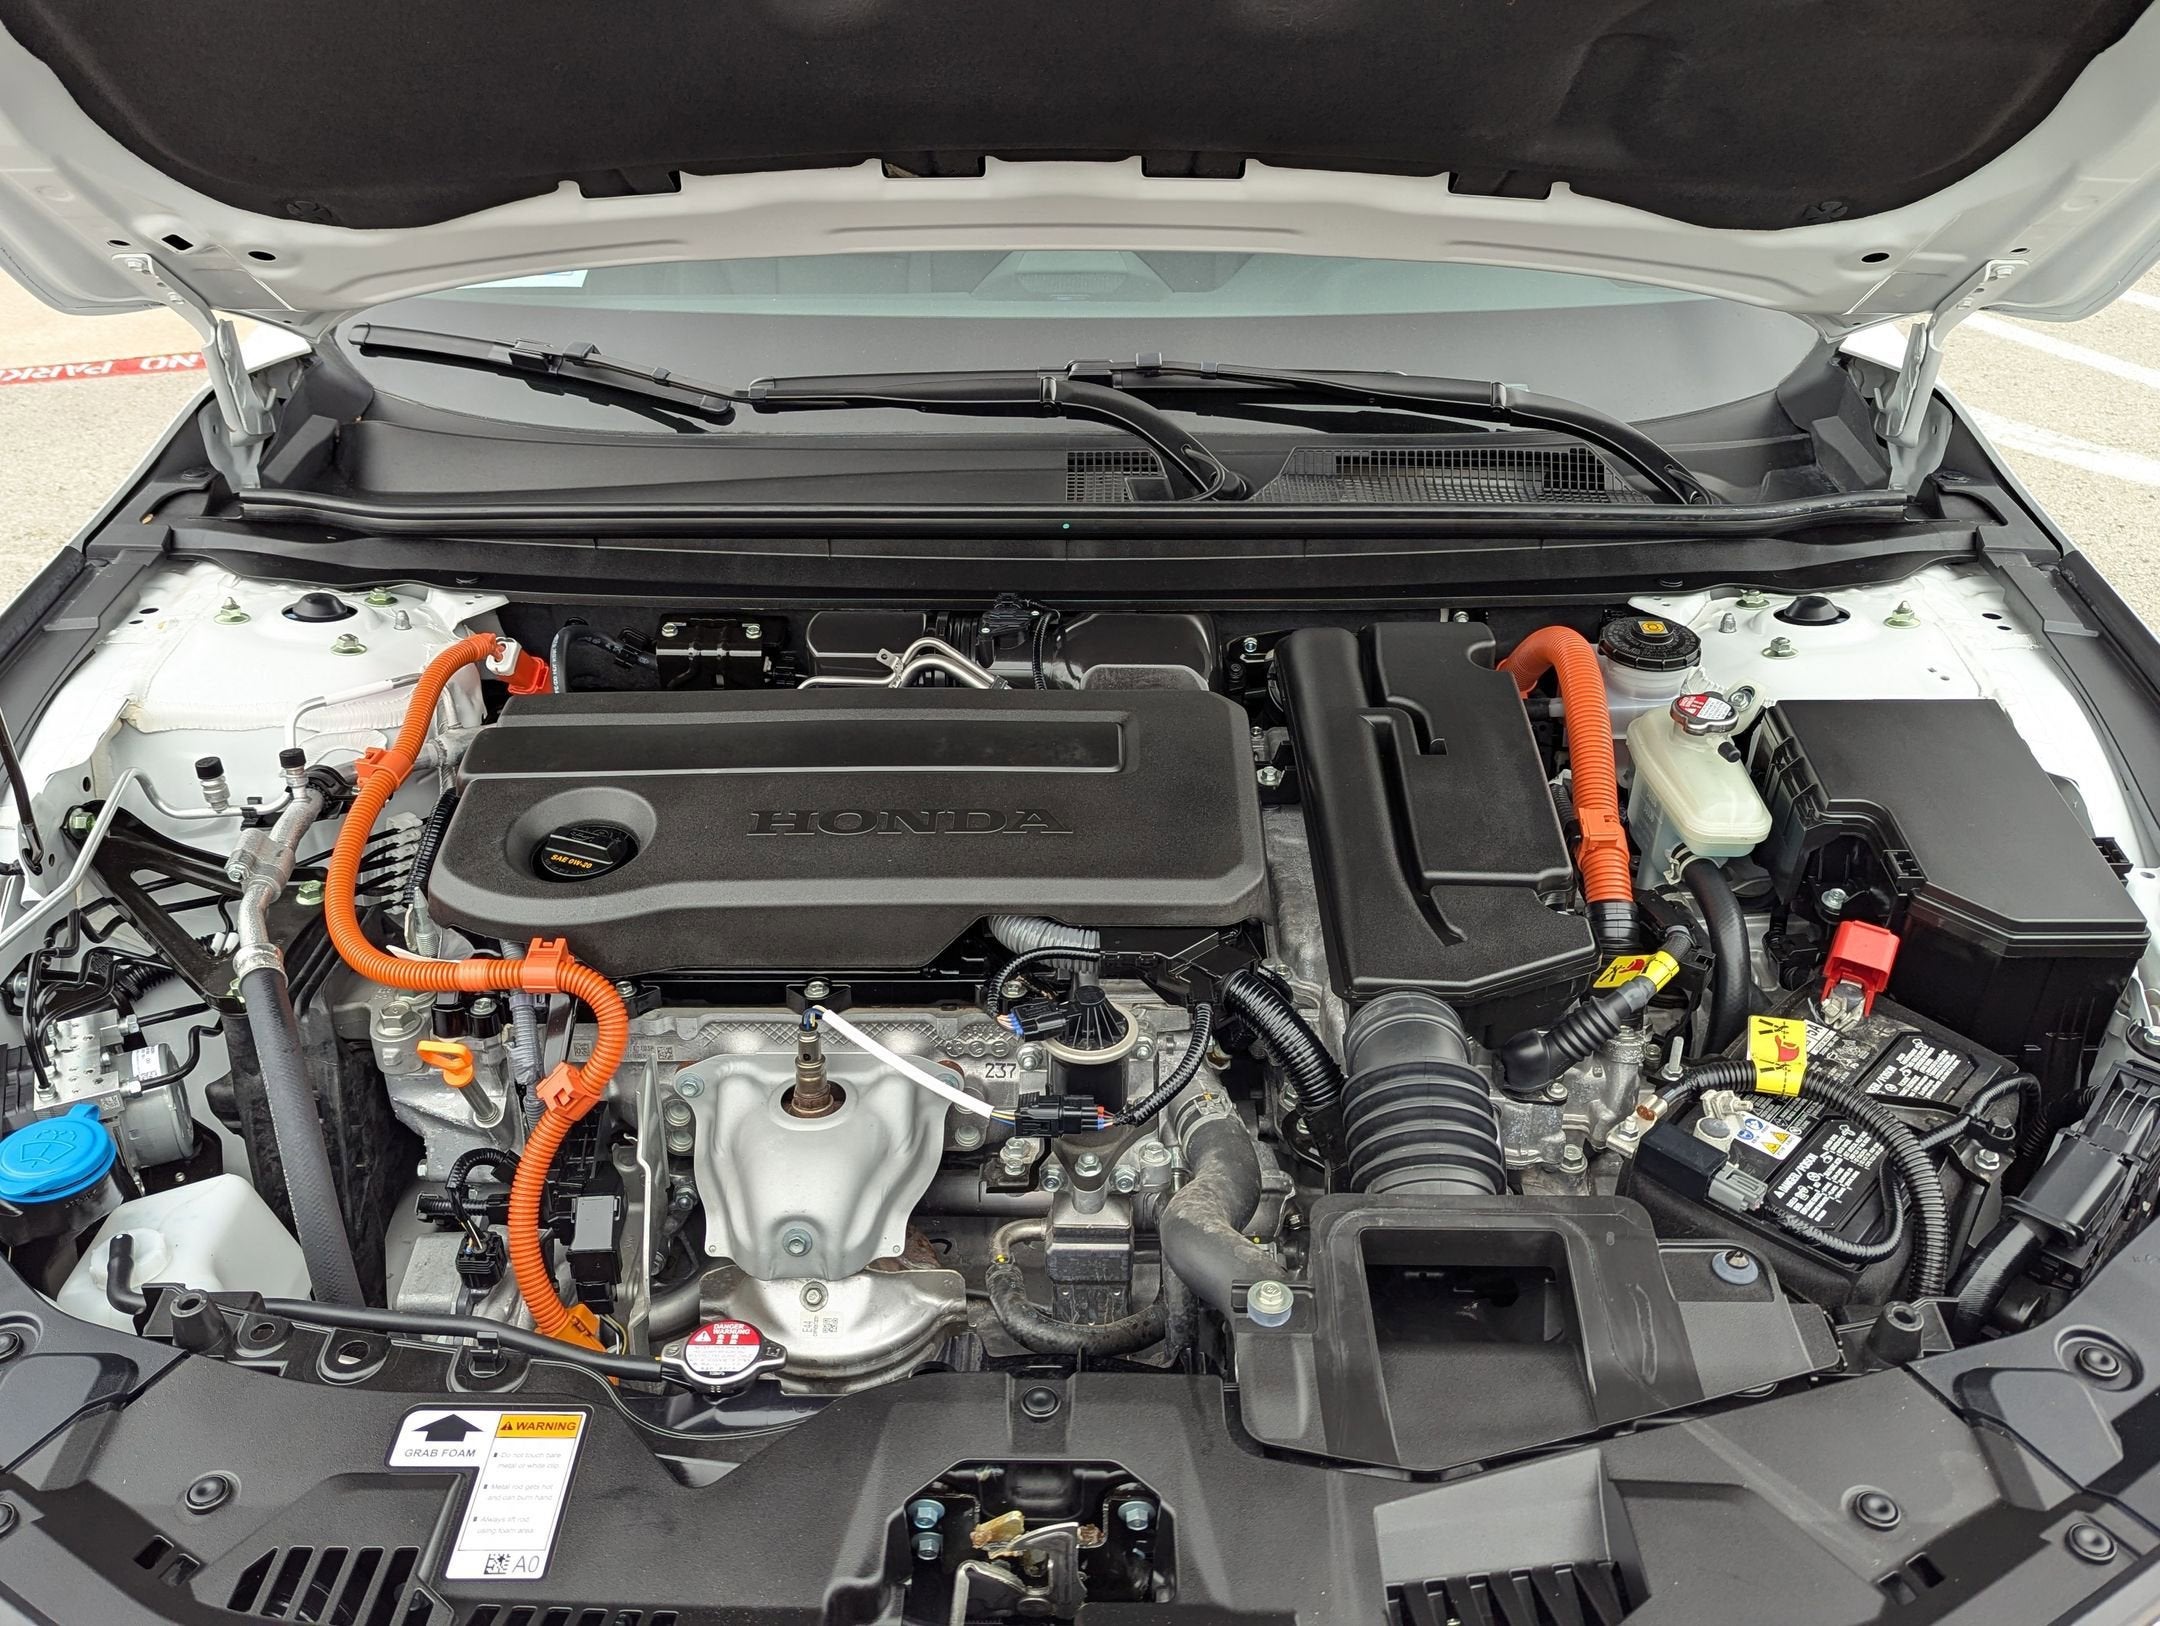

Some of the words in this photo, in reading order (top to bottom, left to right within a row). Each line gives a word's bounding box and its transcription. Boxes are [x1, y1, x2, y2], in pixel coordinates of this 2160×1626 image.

[140, 354, 200, 369] NO
[746, 808, 1074, 836] HONDA
[551, 854, 568, 863] SAE
[568, 858, 593, 869] 0W-20
[985, 1062, 1017, 1079] 237
[516, 1422, 577, 1431] WARNING
[404, 1448, 438, 1458] GRAB
[441, 1448, 476, 1458] FOAM
[512, 1555, 540, 1573] A0
